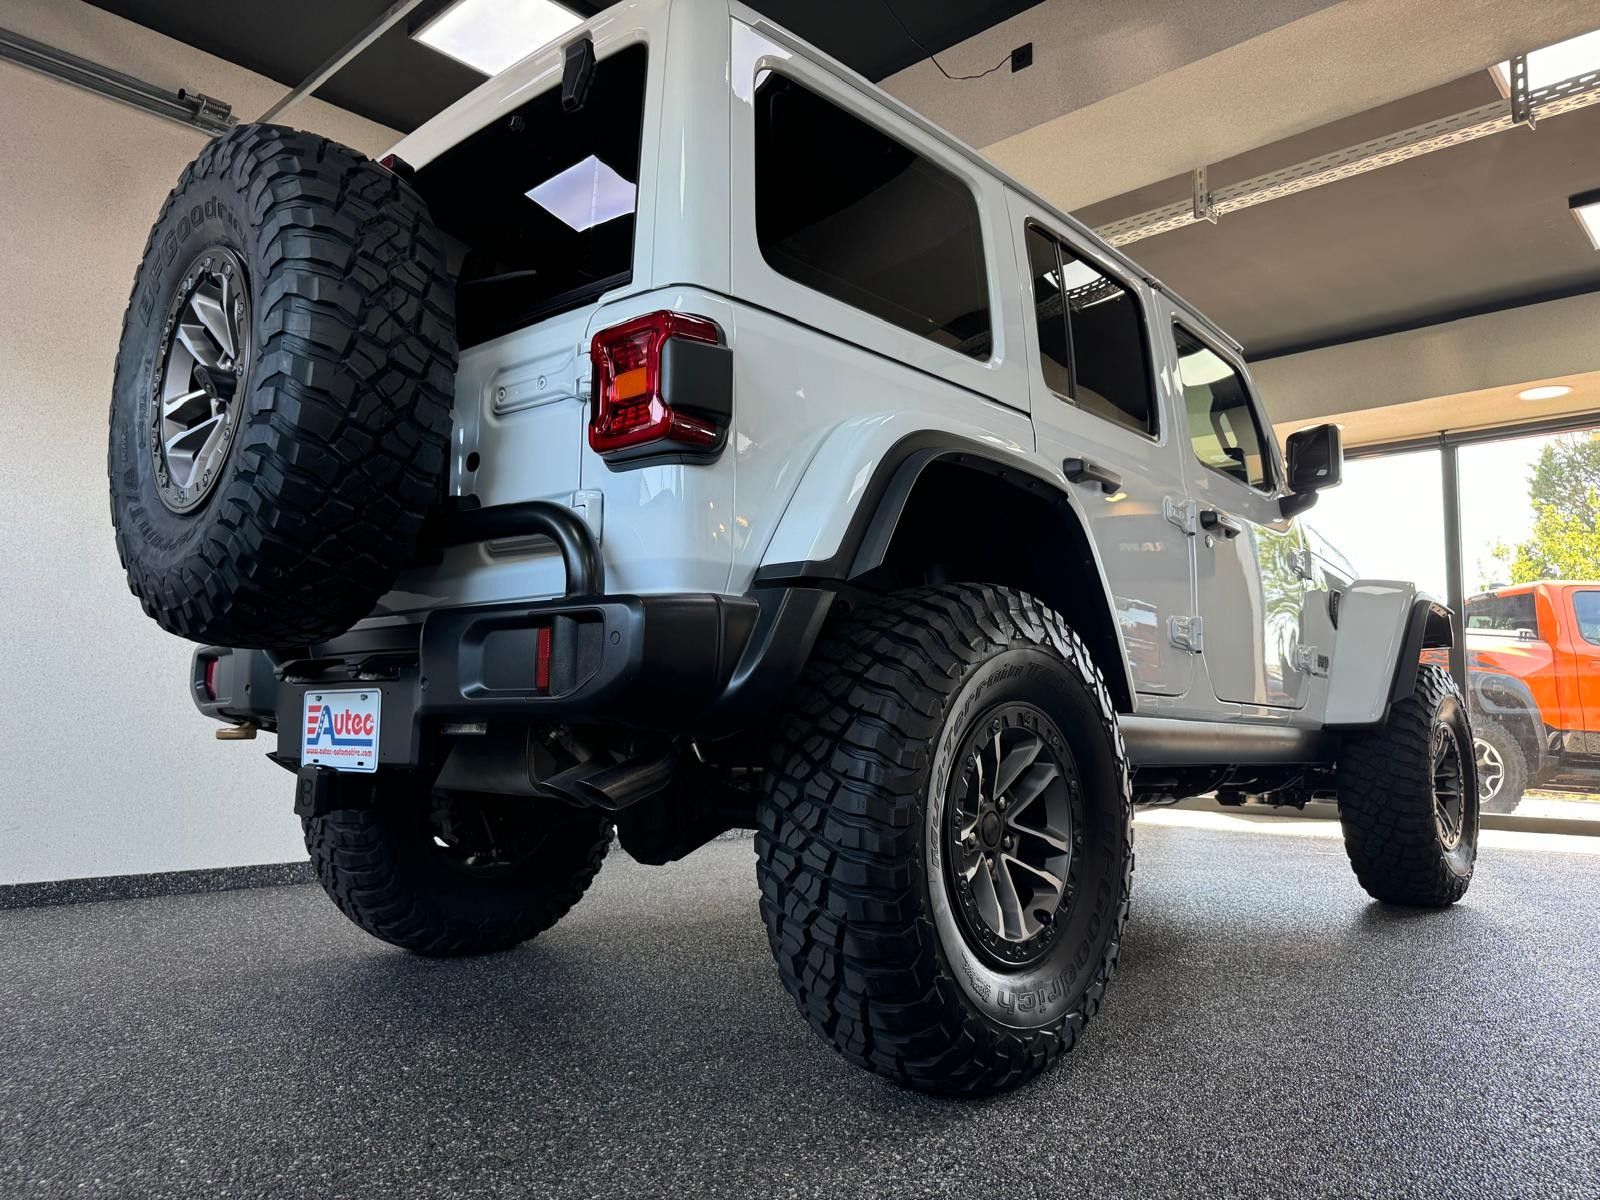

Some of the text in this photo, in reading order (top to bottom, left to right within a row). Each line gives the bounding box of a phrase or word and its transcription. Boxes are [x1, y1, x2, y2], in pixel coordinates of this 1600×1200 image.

[314, 704, 374, 743] Autec
[306, 748, 372, 757] www.autec-automotive.com
[931, 663, 1024, 870] Mud-Terrain
